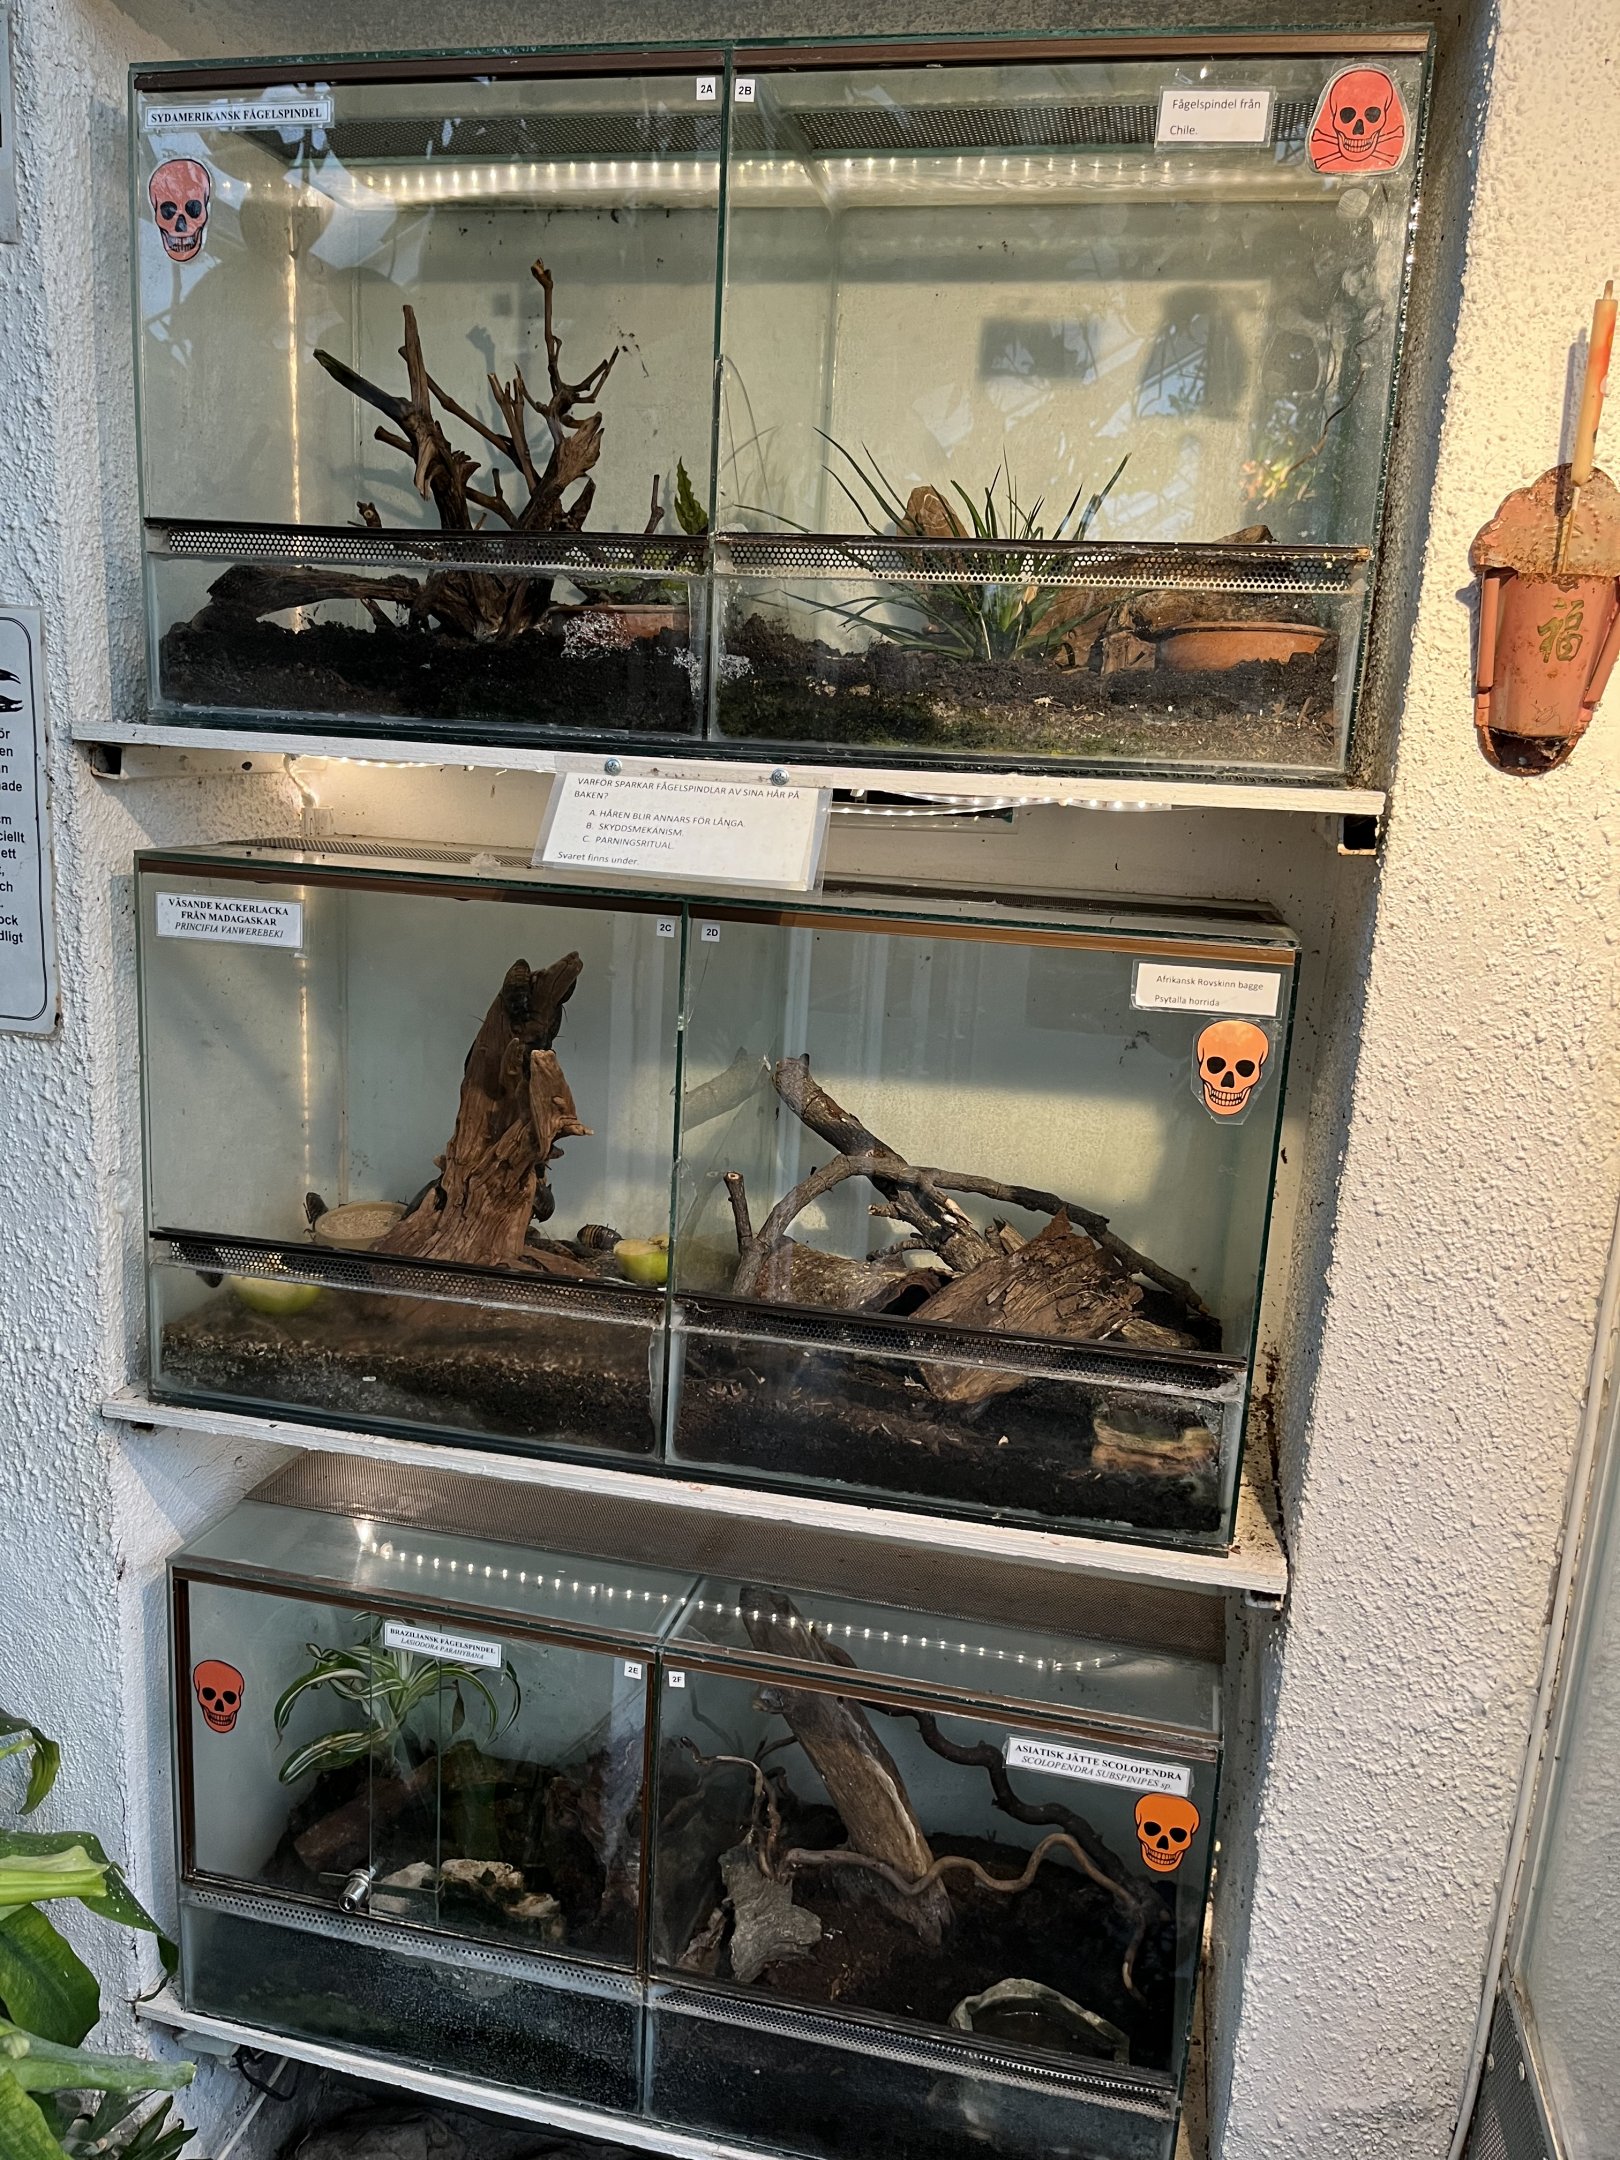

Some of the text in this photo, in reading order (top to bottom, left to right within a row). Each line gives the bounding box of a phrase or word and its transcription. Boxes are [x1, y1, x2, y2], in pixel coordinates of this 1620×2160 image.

[701, 85, 712, 93] 2A
[739, 86, 751, 95] 2B
[1172, 98, 1261, 111] Fågelspindel från
[151, 107, 322, 123] SYDAMERIKANSK FÅGELSPINDEL
[1170, 125, 1198, 135] Chile.
[1536, 597, 1585, 663] 福
[574, 790, 608, 799] BAKEN?
[578, 778, 613, 787] VARFÖR
[615, 780, 654, 790] SPARKAR
[656, 782, 726, 795] FÅGELSPINDLAR
[743, 789, 764, 797] SINA
[766, 789, 785, 799] HÅR
[788, 791, 800, 799] PÅ
[600, 809, 630, 819] HÅREN
[632, 813, 651, 821] BLIR
[653, 815, 690, 823] ANNARS
[692, 816, 711, 825] FÖR
[599, 823, 684, 837] SKYDDSMEKANISM.
[558, 851, 639, 865] Svaret finns under.
[168, 897, 289, 916] VÄSANDE KACKERLACKA
[181, 910, 277, 926] FRÅN MADAGASKAR
[174, 921, 219, 933] PRINCIFIA
[660, 923, 672, 932] 2C
[706, 929, 718, 937] 2D
[1156, 975, 1264, 991] Afrikansk Rovskinn bagge
[1154, 994, 1220, 1007] Psytalla horrida
[390, 1628, 496, 1654] BRAZILIANSK FÅGELSPINDEL
[628, 1666, 638, 1674] 2E
[1015, 1744, 1182, 1781] ASIATISK JÄTTE SCOLOPENDRA
[1021, 1755, 1094, 1776] SCOLOPENDRA
[1095, 1769, 1160, 1787] SUBSPINIPES
